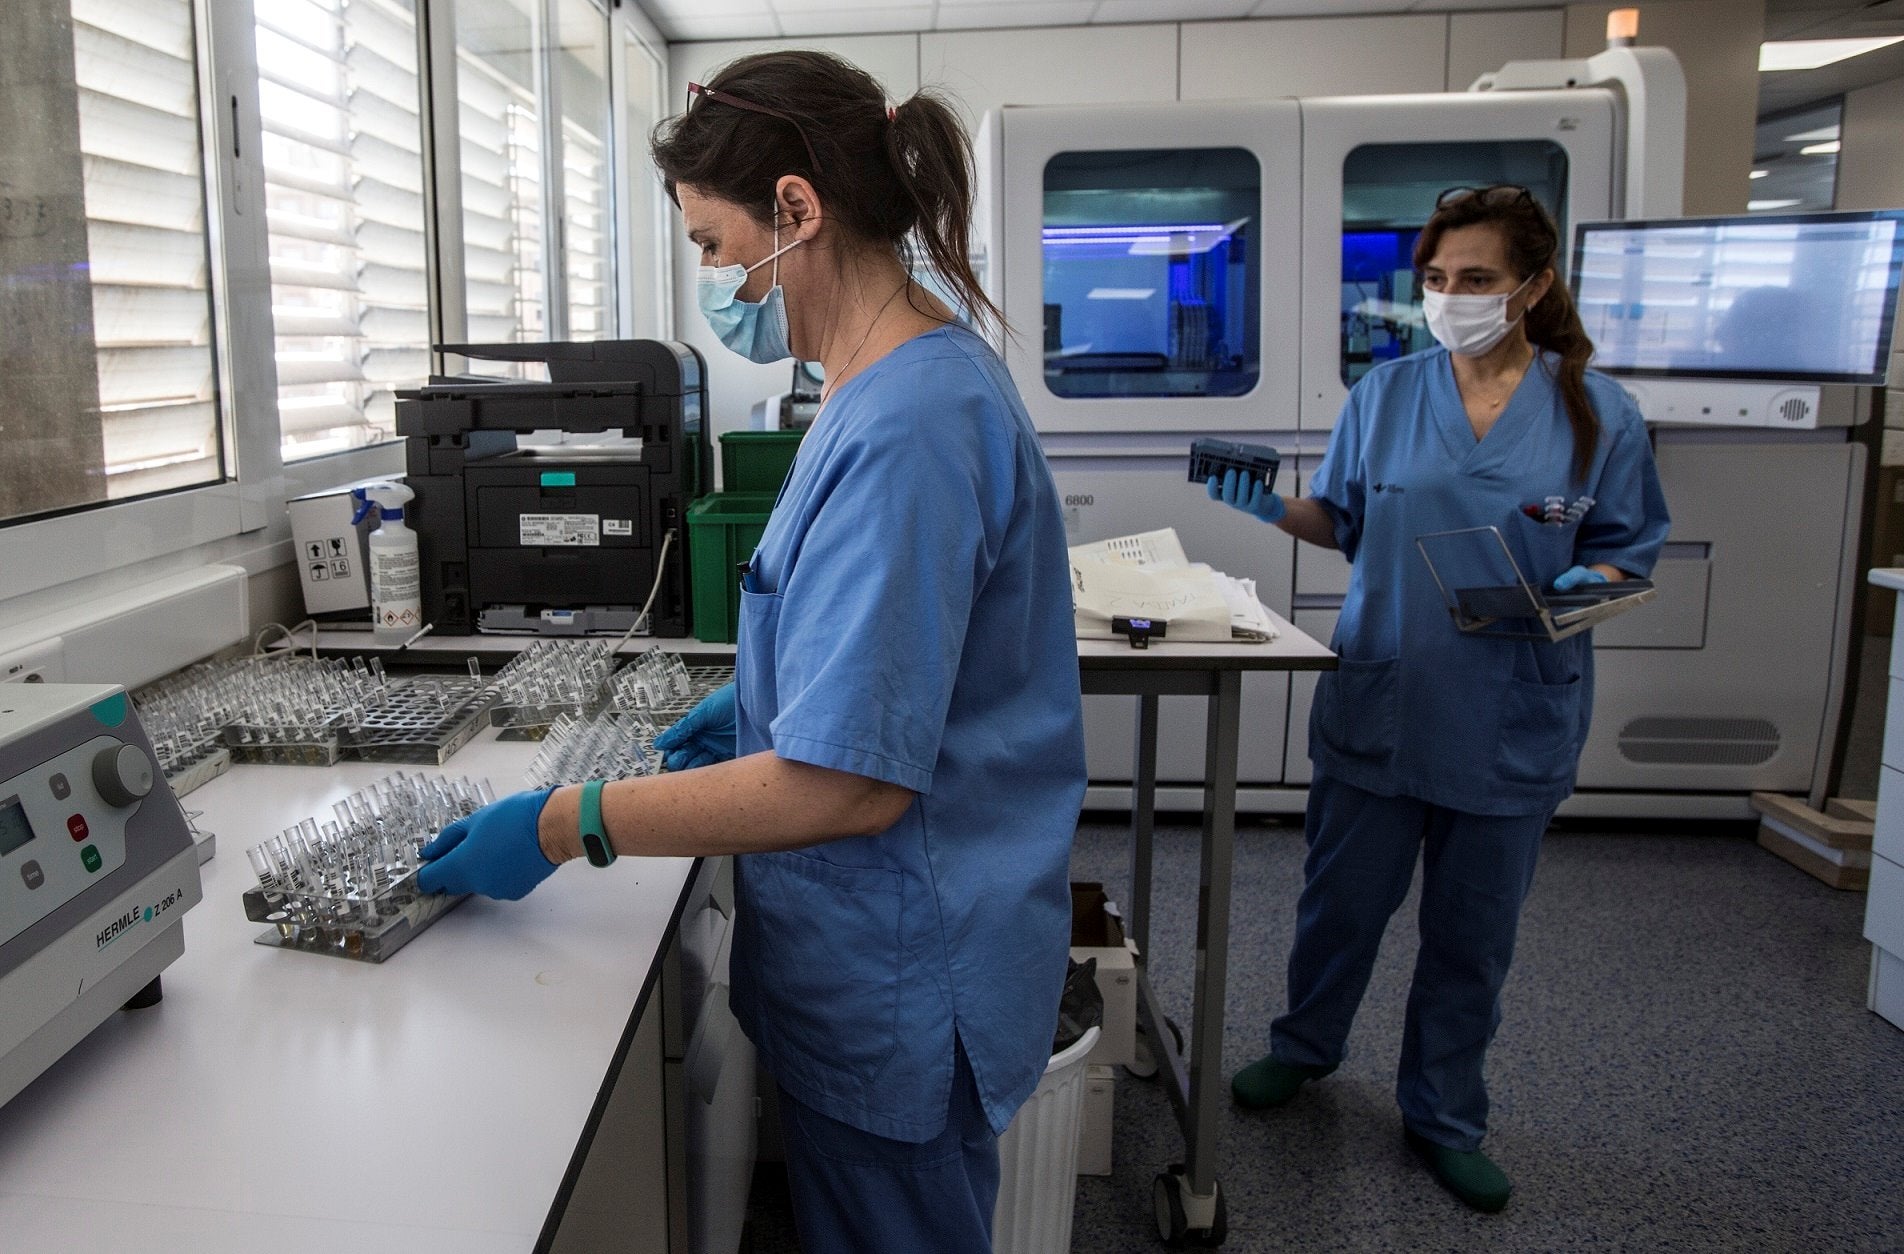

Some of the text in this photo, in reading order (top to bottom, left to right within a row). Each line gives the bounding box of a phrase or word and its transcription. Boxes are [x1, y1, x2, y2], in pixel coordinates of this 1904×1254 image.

[1065, 494, 1094, 506] 6800
[331, 561, 347, 571] 16
[87, 854, 98, 864] start
[96, 888, 183, 948] HERMLE Z 206 A
